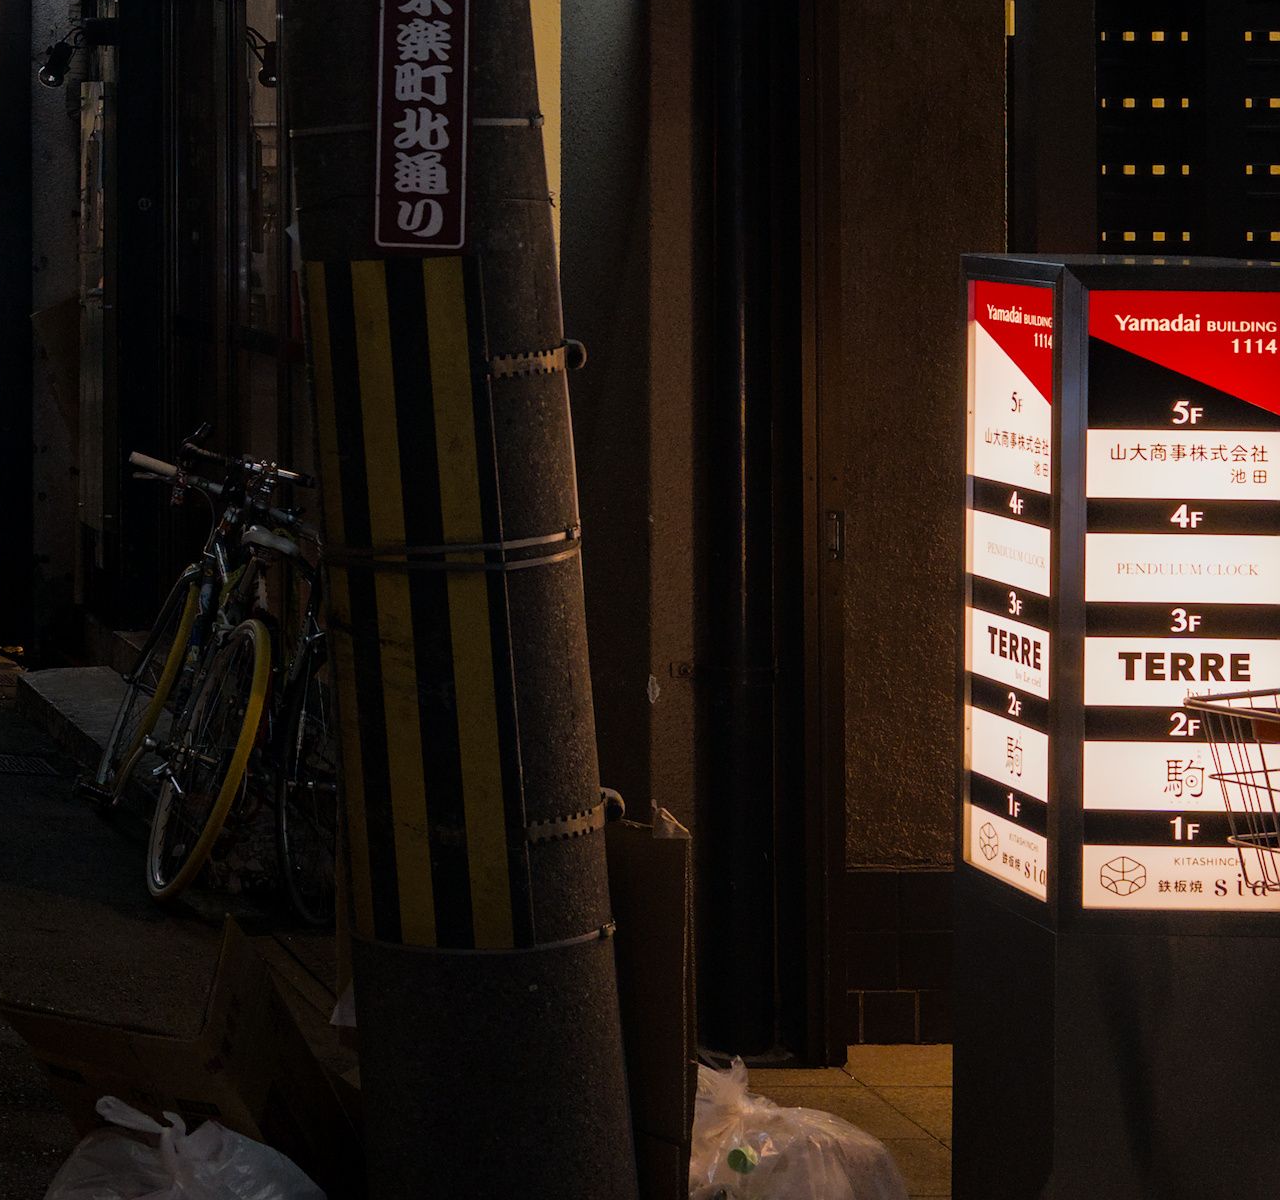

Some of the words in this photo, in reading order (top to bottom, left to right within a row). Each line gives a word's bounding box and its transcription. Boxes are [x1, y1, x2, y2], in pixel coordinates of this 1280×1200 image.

[987, 304, 1022, 324] Yamadai
[1023, 314, 1052, 329] BUILDING
[1114, 313, 1201, 333] Yamadai
[1206, 321, 1278, 333] BUILDING
[1033, 332, 1052, 349] 1114
[1231, 339, 1278, 354] 1114
[1010, 391, 1023, 414] 5F
[1172, 400, 1204, 425] 5F
[984, 428, 1050, 456] 山大商事株式会社
[1109, 443, 1270, 463] 山大商事株式会社
[1230, 468, 1268, 485] 池田
[1009, 491, 1024, 515] 4F
[1169, 504, 1204, 529] 4F
[1116, 562, 1202, 576] PENDULUM
[1205, 562, 1259, 576] CLOCK
[1008, 590, 1023, 616] 3F
[1170, 608, 1202, 633] 3F
[987, 625, 1042, 671] TERRE
[1118, 651, 1252, 682] TERRE
[1007, 692, 1022, 717] 2F
[1169, 711, 1201, 737] 2F
[1163, 759, 1205, 798] 駒
[1007, 793, 1021, 818] 1F
[1170, 816, 1200, 841] 1F
[1173, 857, 1246, 867] KITASHINCHI
[1158, 879, 1204, 893] 鉄板焼
